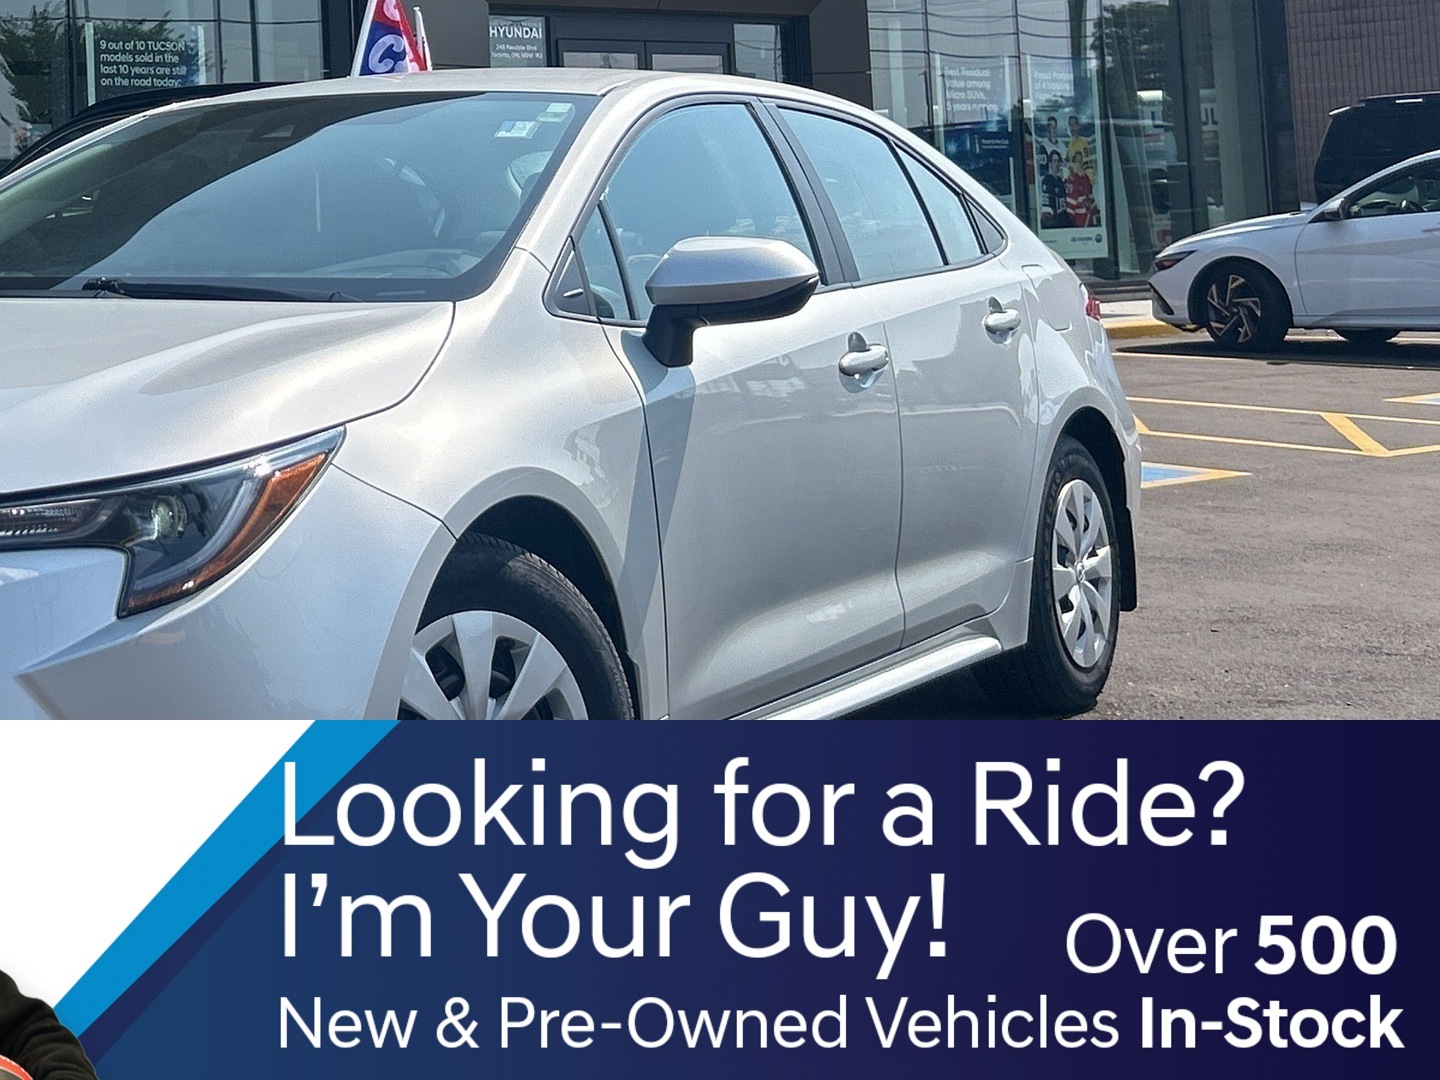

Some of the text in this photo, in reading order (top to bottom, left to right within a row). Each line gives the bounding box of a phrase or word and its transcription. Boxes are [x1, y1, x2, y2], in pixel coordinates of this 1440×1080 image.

[489, 26, 542, 39] HYUNDAI
[100, 40, 186, 51] 9 out of 10 TUCSON
[100, 52, 179, 63] models sold in the
[100, 64, 187, 76] last 10 years are still
[101, 78, 113, 86] on
[114, 77, 130, 86] the
[131, 77, 152, 86] road
